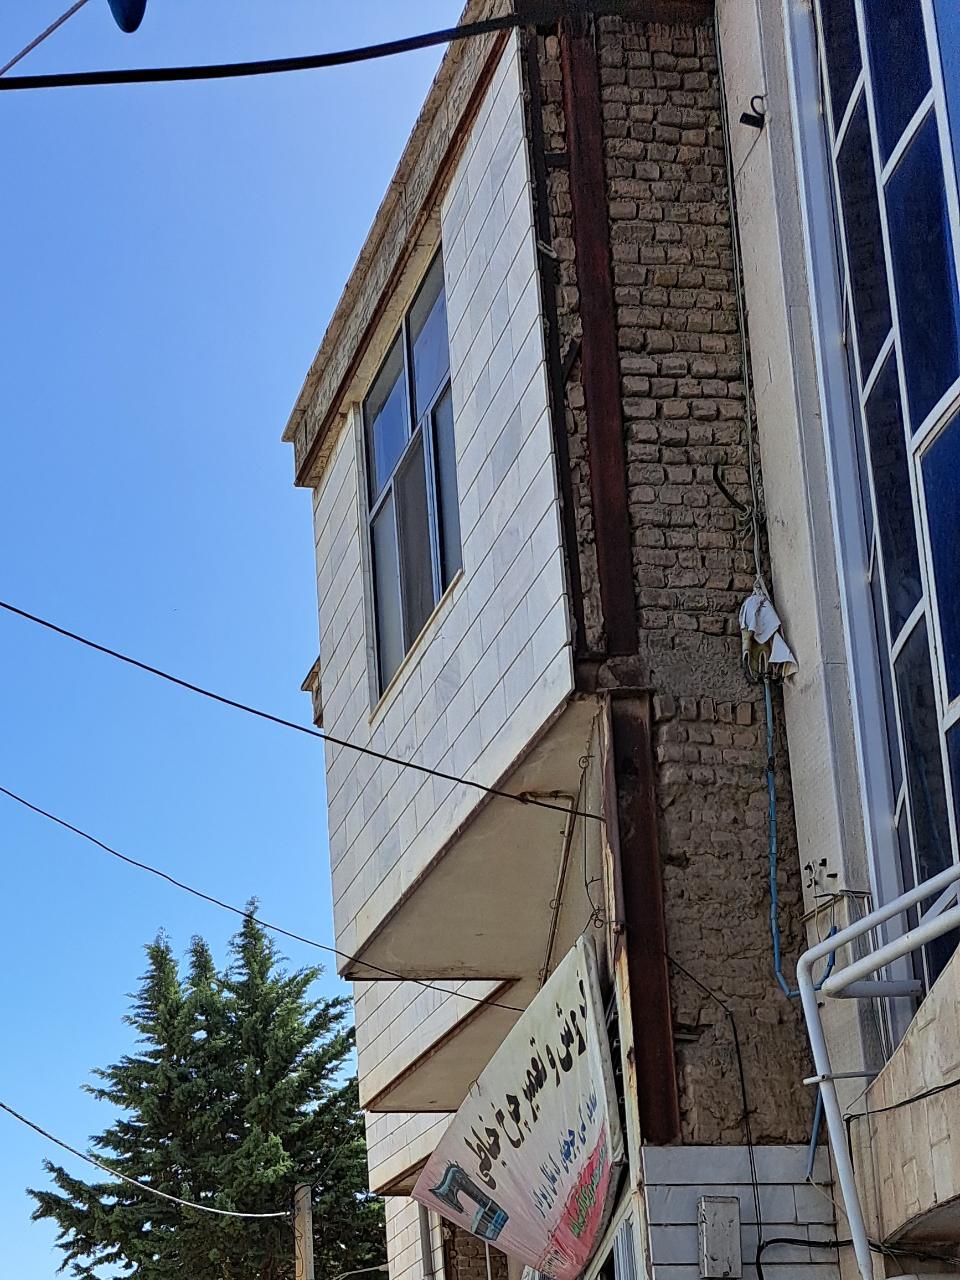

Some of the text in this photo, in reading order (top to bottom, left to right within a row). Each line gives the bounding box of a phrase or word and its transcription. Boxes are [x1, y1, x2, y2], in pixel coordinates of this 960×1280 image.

[522, 1037, 547, 1123] تعمیر
[545, 1044, 560, 1088] و
[464, 1114, 506, 1191] خیاطی
[491, 1093, 532, 1149] چرخ
